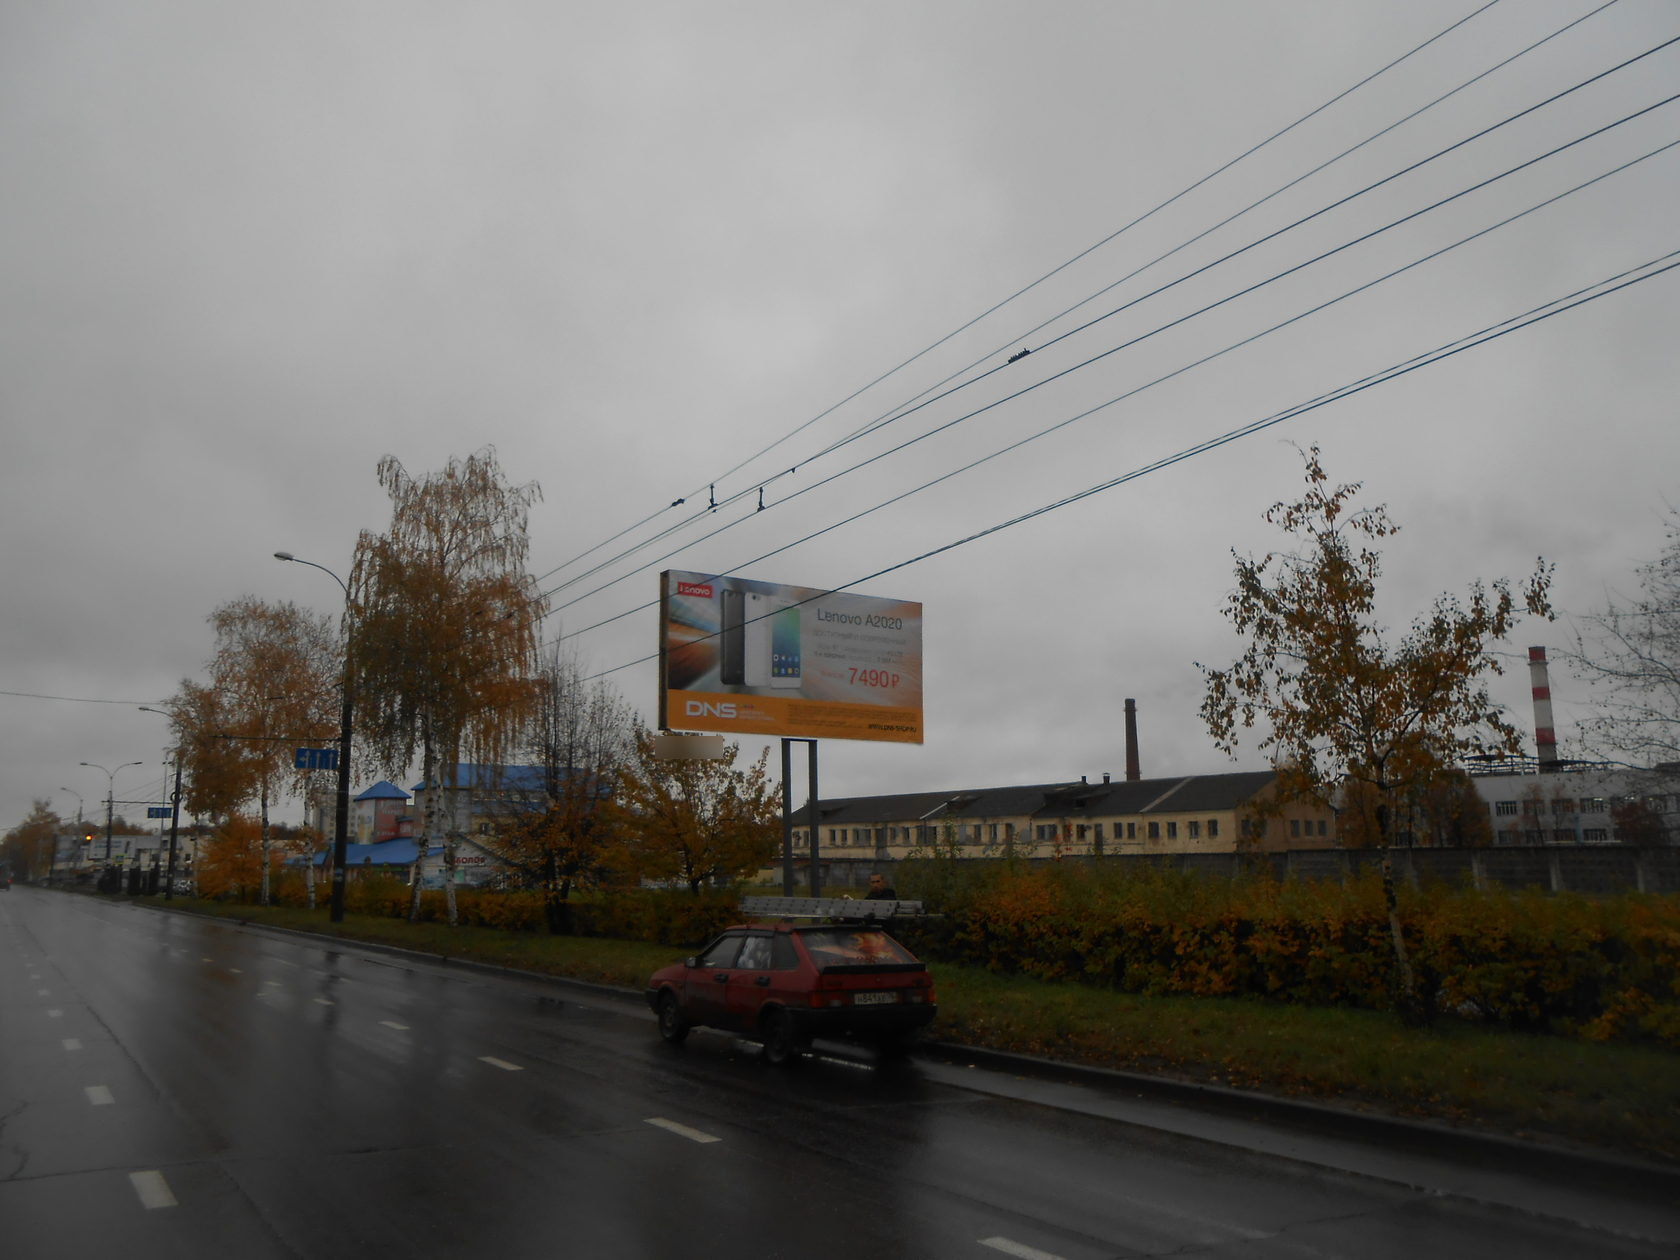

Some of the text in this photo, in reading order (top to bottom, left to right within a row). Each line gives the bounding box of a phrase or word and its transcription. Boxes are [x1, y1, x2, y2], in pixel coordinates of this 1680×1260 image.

[817, 608, 903, 630] Lenovo A2020
[686, 700, 737, 719] DNS
